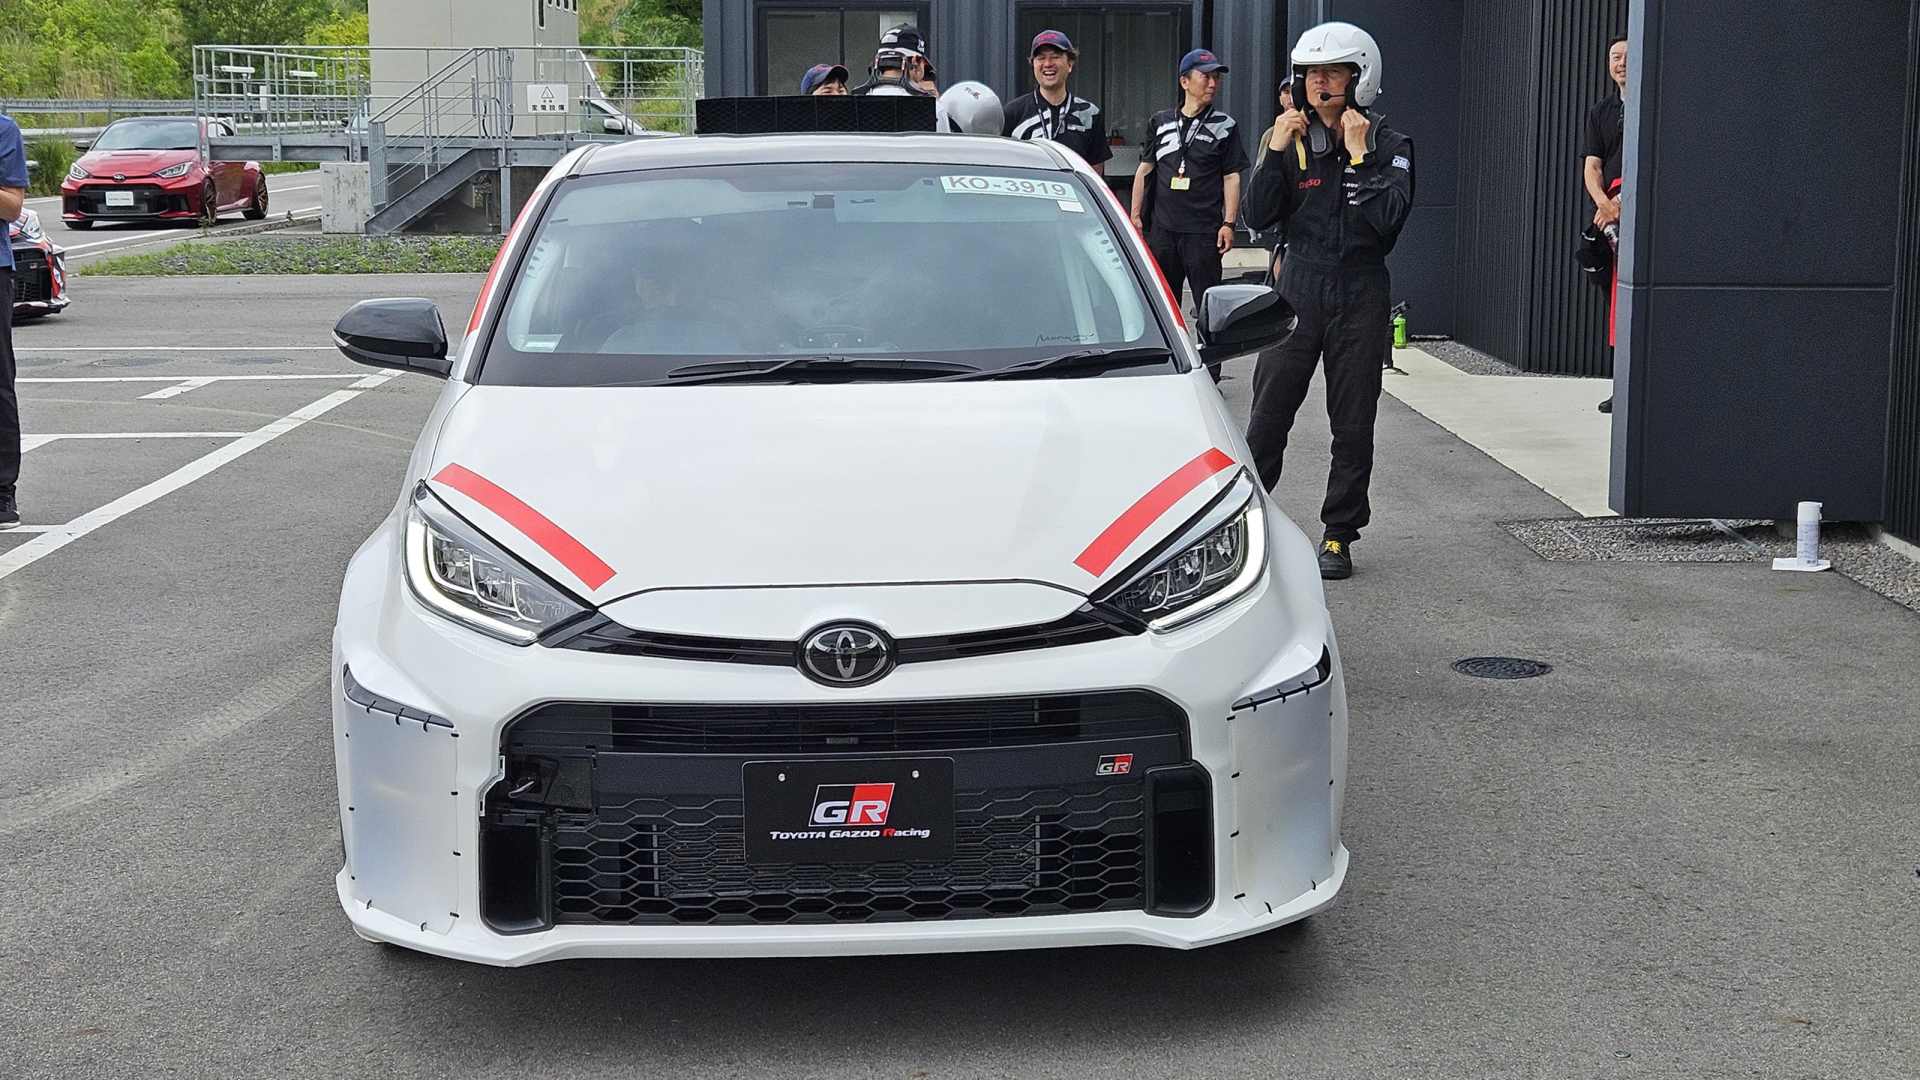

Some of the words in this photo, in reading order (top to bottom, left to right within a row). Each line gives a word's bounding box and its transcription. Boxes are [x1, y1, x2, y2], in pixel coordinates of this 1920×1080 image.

[948, 176, 1067, 196] KO-3919
[1099, 761, 1129, 773] GR
[813, 800, 887, 824] GR
[769, 830, 827, 841] TOYOTA
[829, 829, 880, 839] GAZOO
[882, 827, 931, 840] Racing
